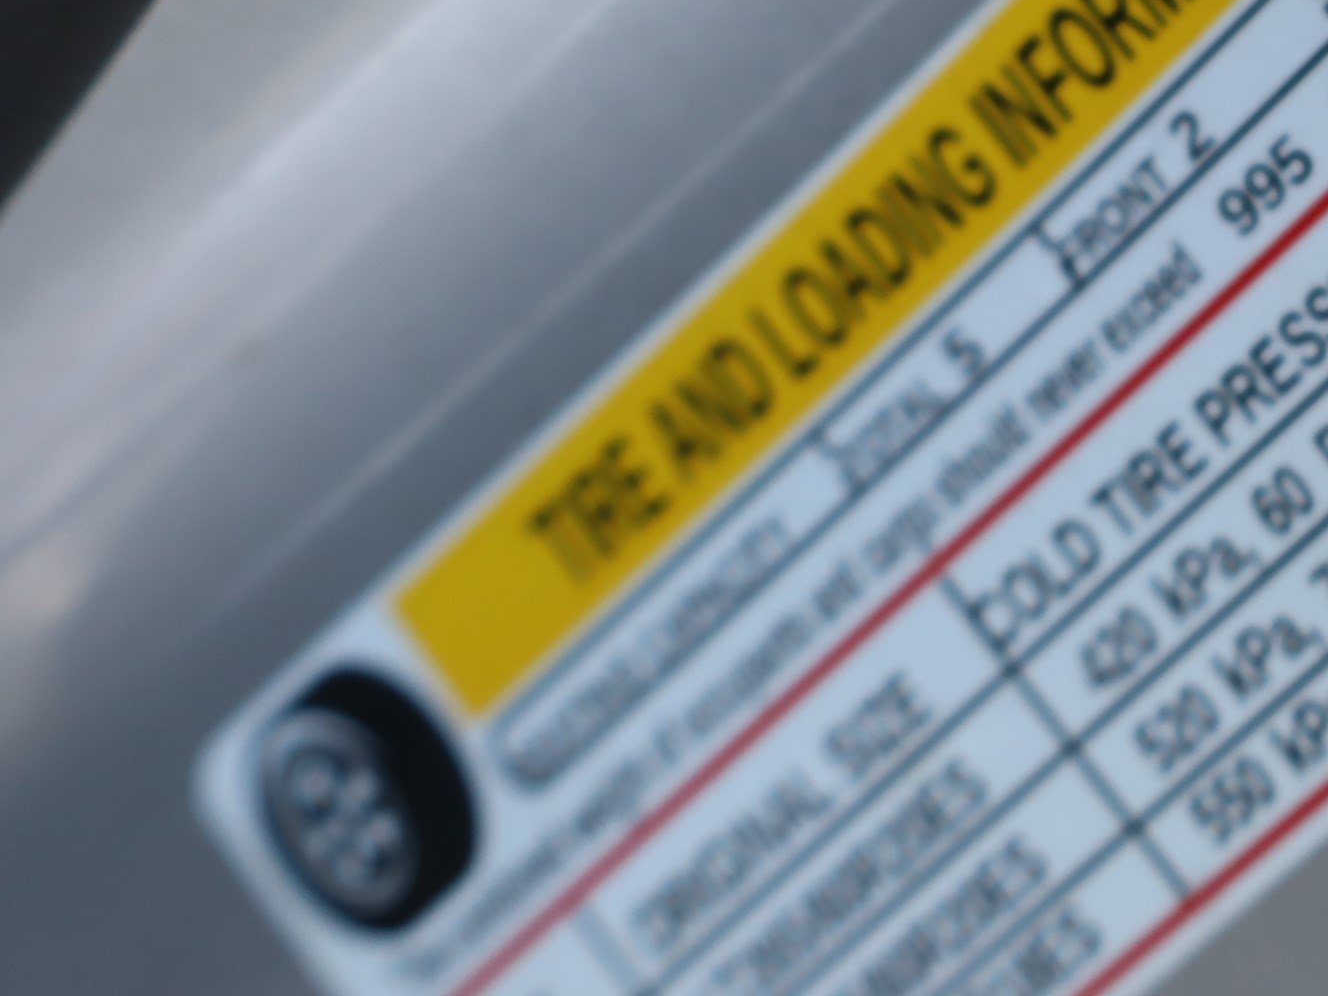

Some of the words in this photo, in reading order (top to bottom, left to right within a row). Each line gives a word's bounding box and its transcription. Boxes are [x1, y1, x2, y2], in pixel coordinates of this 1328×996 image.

[1029, 343, 1095, 413] never
[1101, 244, 1202, 352] exceed
[1218, 136, 1312, 234] 995
[1052, 156, 1167, 275] FRONT
[1169, 110, 1217, 166] 2
[526, 434, 673, 581] TIRE
[643, 335, 777, 478] AND
[753, 125, 996, 380] LOADING
[942, 330, 994, 384] 5
[966, 519, 1101, 650] COLD
[1090, 422, 1207, 529] TIRE
[1081, 607, 1158, 688] 420
[1251, 466, 1313, 535] 60
